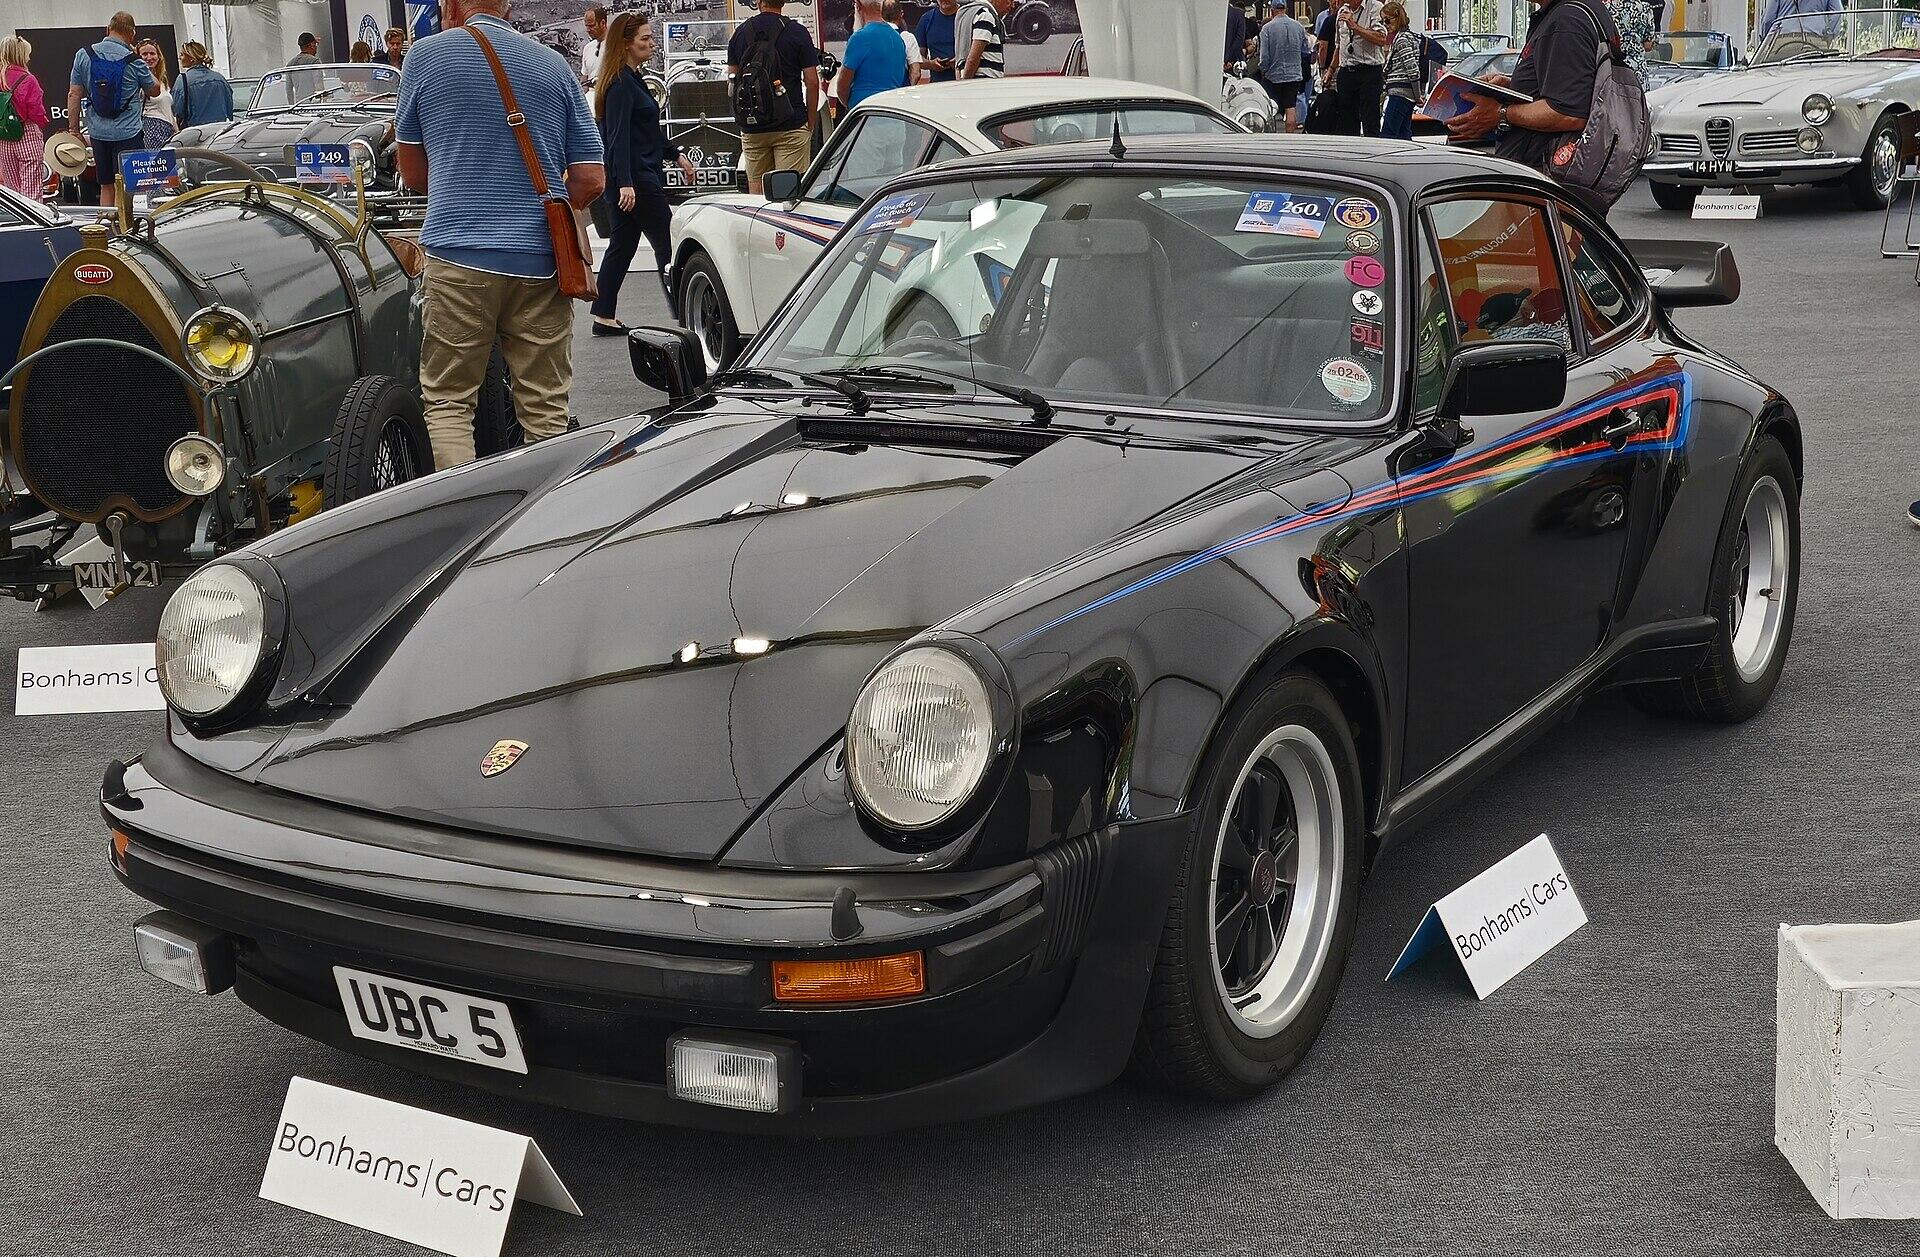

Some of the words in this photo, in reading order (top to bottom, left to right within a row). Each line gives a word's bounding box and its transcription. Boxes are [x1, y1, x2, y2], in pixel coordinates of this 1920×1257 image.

[131, 159, 156, 167] Please
[157, 157, 167, 165] do
[317, 151, 345, 164] 249.
[147, 164, 168, 173] touch
[1278, 201, 1322, 218] 260.
[76, 270, 109, 279] BUGATTI
[1350, 260, 1381, 280] FC
[1351, 325, 1383, 348] 911
[348, 978, 459, 1048] UBC
[467, 1004, 507, 1060] 5
